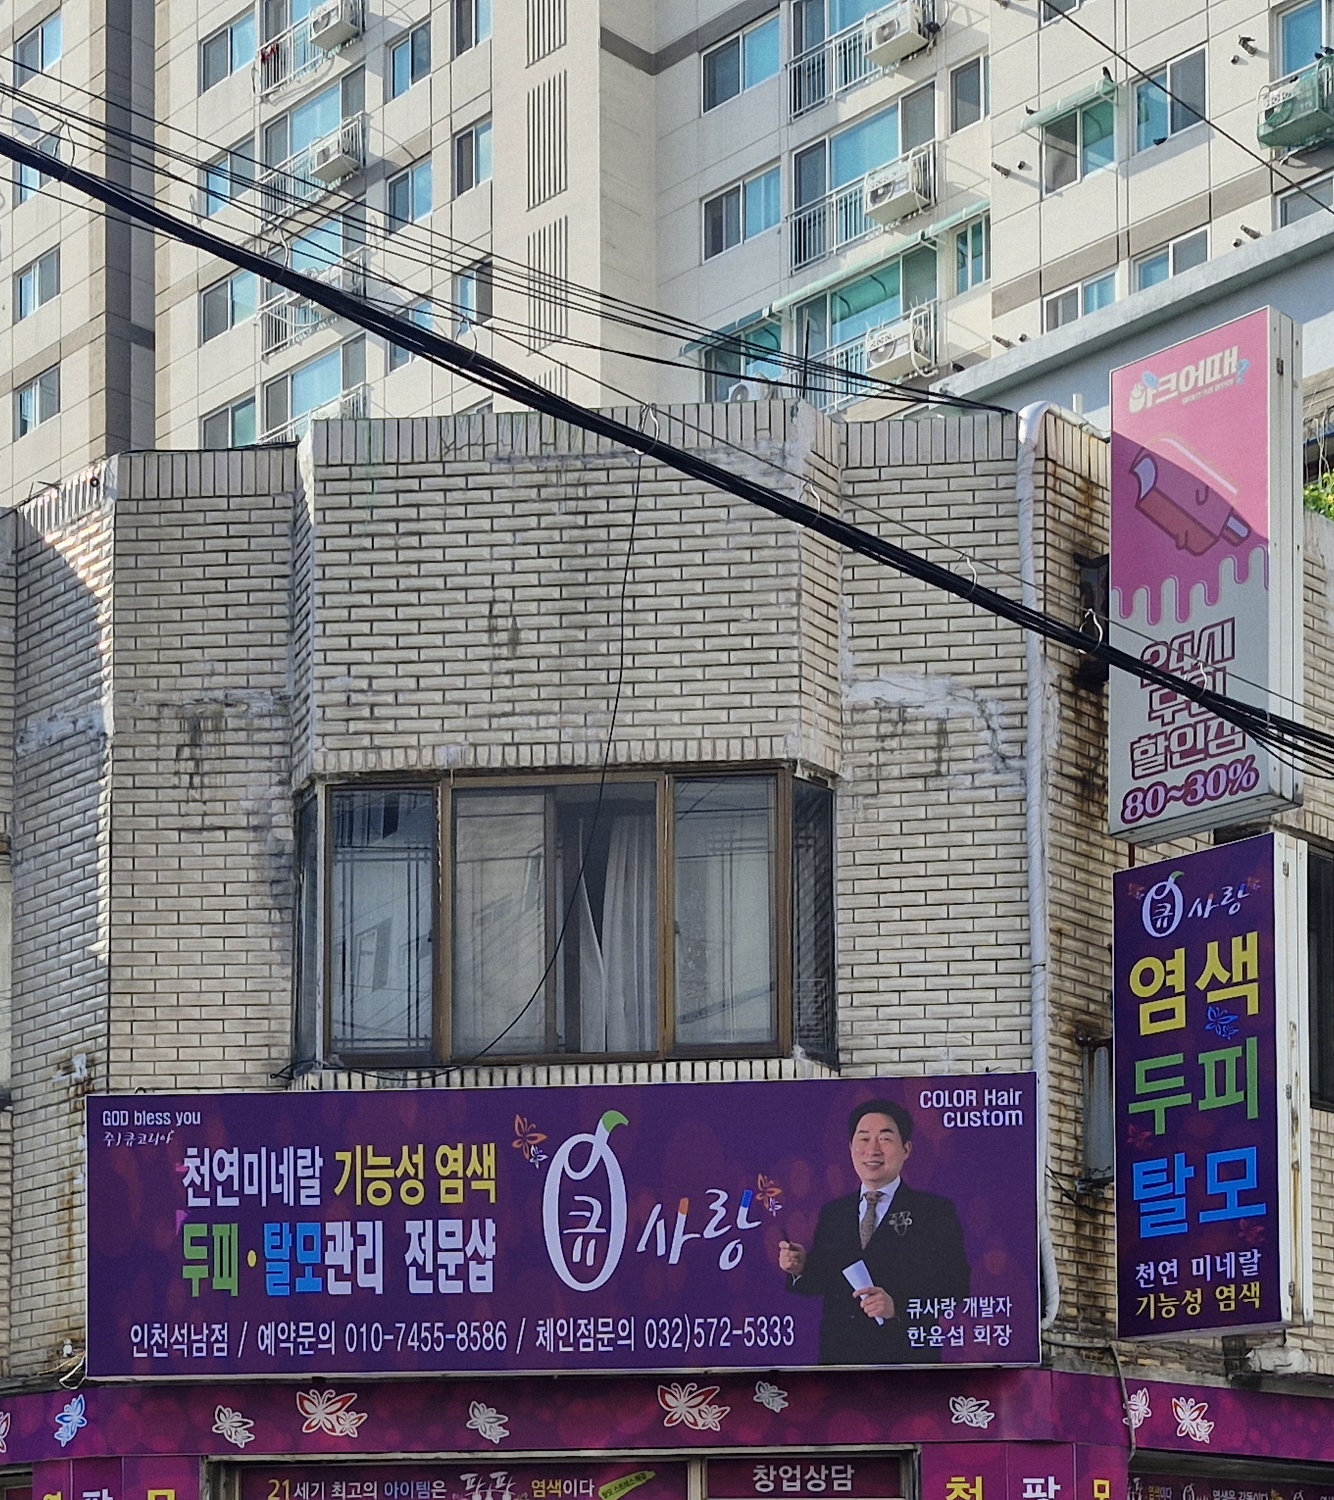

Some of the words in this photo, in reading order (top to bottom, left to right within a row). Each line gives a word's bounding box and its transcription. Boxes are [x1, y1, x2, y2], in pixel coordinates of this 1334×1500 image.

[1121, 754, 1259, 824] 80~30%
[1128, 930, 1260, 1035] 염색
[919, 1089, 977, 1110] COLOR
[984, 1087, 1023, 1107] Hair
[1128, 1036, 1260, 1136] 두피
[102, 1110, 129, 1127] GOD
[134, 1109, 172, 1126] bless
[175, 1111, 201, 1127] you
[942, 1108, 1023, 1128] custom
[182, 1146, 323, 1208] 천연미네랄
[334, 1143, 425, 1206] 기능성
[435, 1142, 497, 1205] 염색
[1132, 1146, 1266, 1238] 탈모
[404, 1218, 496, 1294] 전문샵
[1136, 1258, 1177, 1289] 천연
[1192, 1248, 1261, 1284] 미네랄
[906, 1299, 956, 1320] 큐사랑
[962, 1296, 1013, 1319] 개발자
[1136, 1287, 1203, 1321] 기능성
[1215, 1280, 1261, 1312] 염색
[130, 1322, 229, 1358] 인천석남점
[257, 1321, 336, 1356] 예약문의
[345, 1321, 507, 1354] 010-7455-8586
[535, 1317, 635, 1354] 체인점문의
[645, 1315, 795, 1352] 032)572-5333
[906, 1325, 965, 1349] 한윤섭
[973, 1323, 1013, 1347] 회장
[267, 1479, 325, 1500] 21세기
[331, 1481, 378, 1500] 최고의
[384, 1479, 447, 1500] 아이템은
[531, 1478, 595, 1498] 염색이다
[752, 1464, 855, 1492] 창업상담
